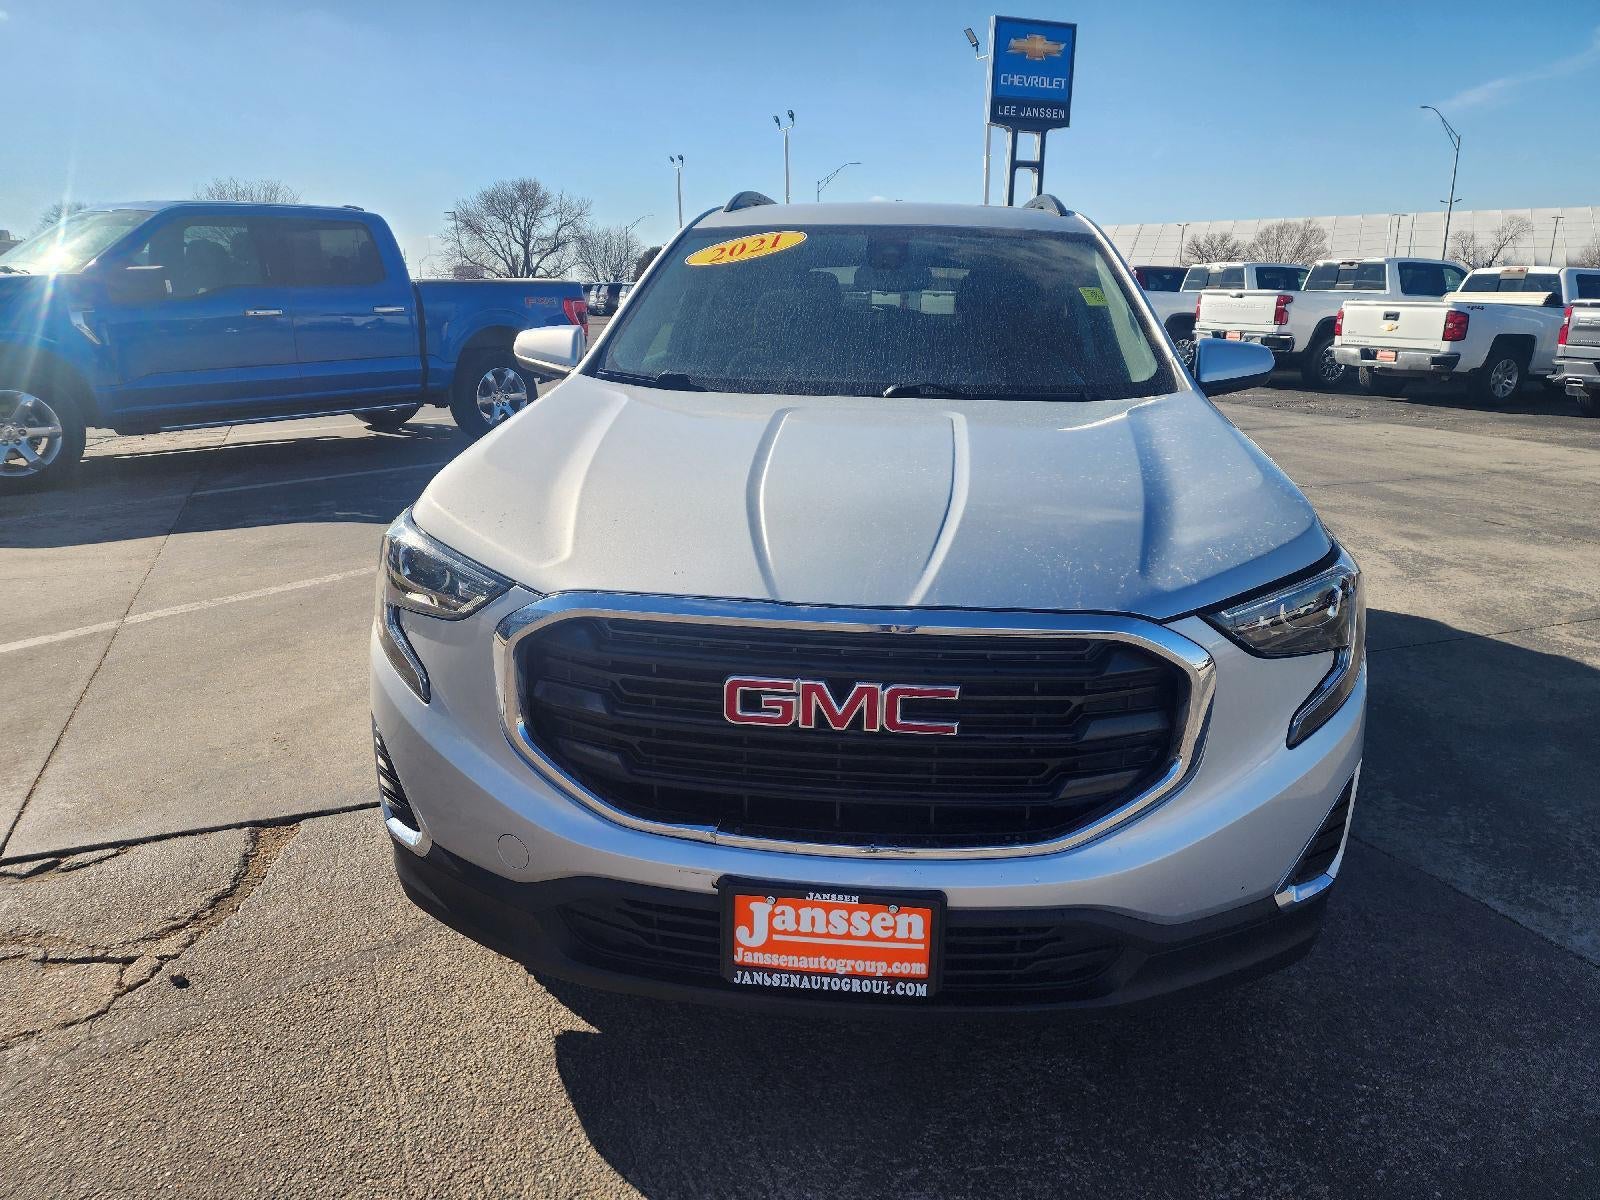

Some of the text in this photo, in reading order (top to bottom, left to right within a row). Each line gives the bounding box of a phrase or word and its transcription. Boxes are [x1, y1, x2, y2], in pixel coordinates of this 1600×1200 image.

[1000, 73, 1067, 89] CHEVROLET
[998, 105, 1065, 119] LEE JANSSEN
[709, 233, 782, 263] 2021
[723, 675, 961, 736] GMC
[805, 892, 860, 904] JANSSEN
[735, 901, 925, 948] Janssen
[733, 947, 926, 977] Janssenautogroup.com
